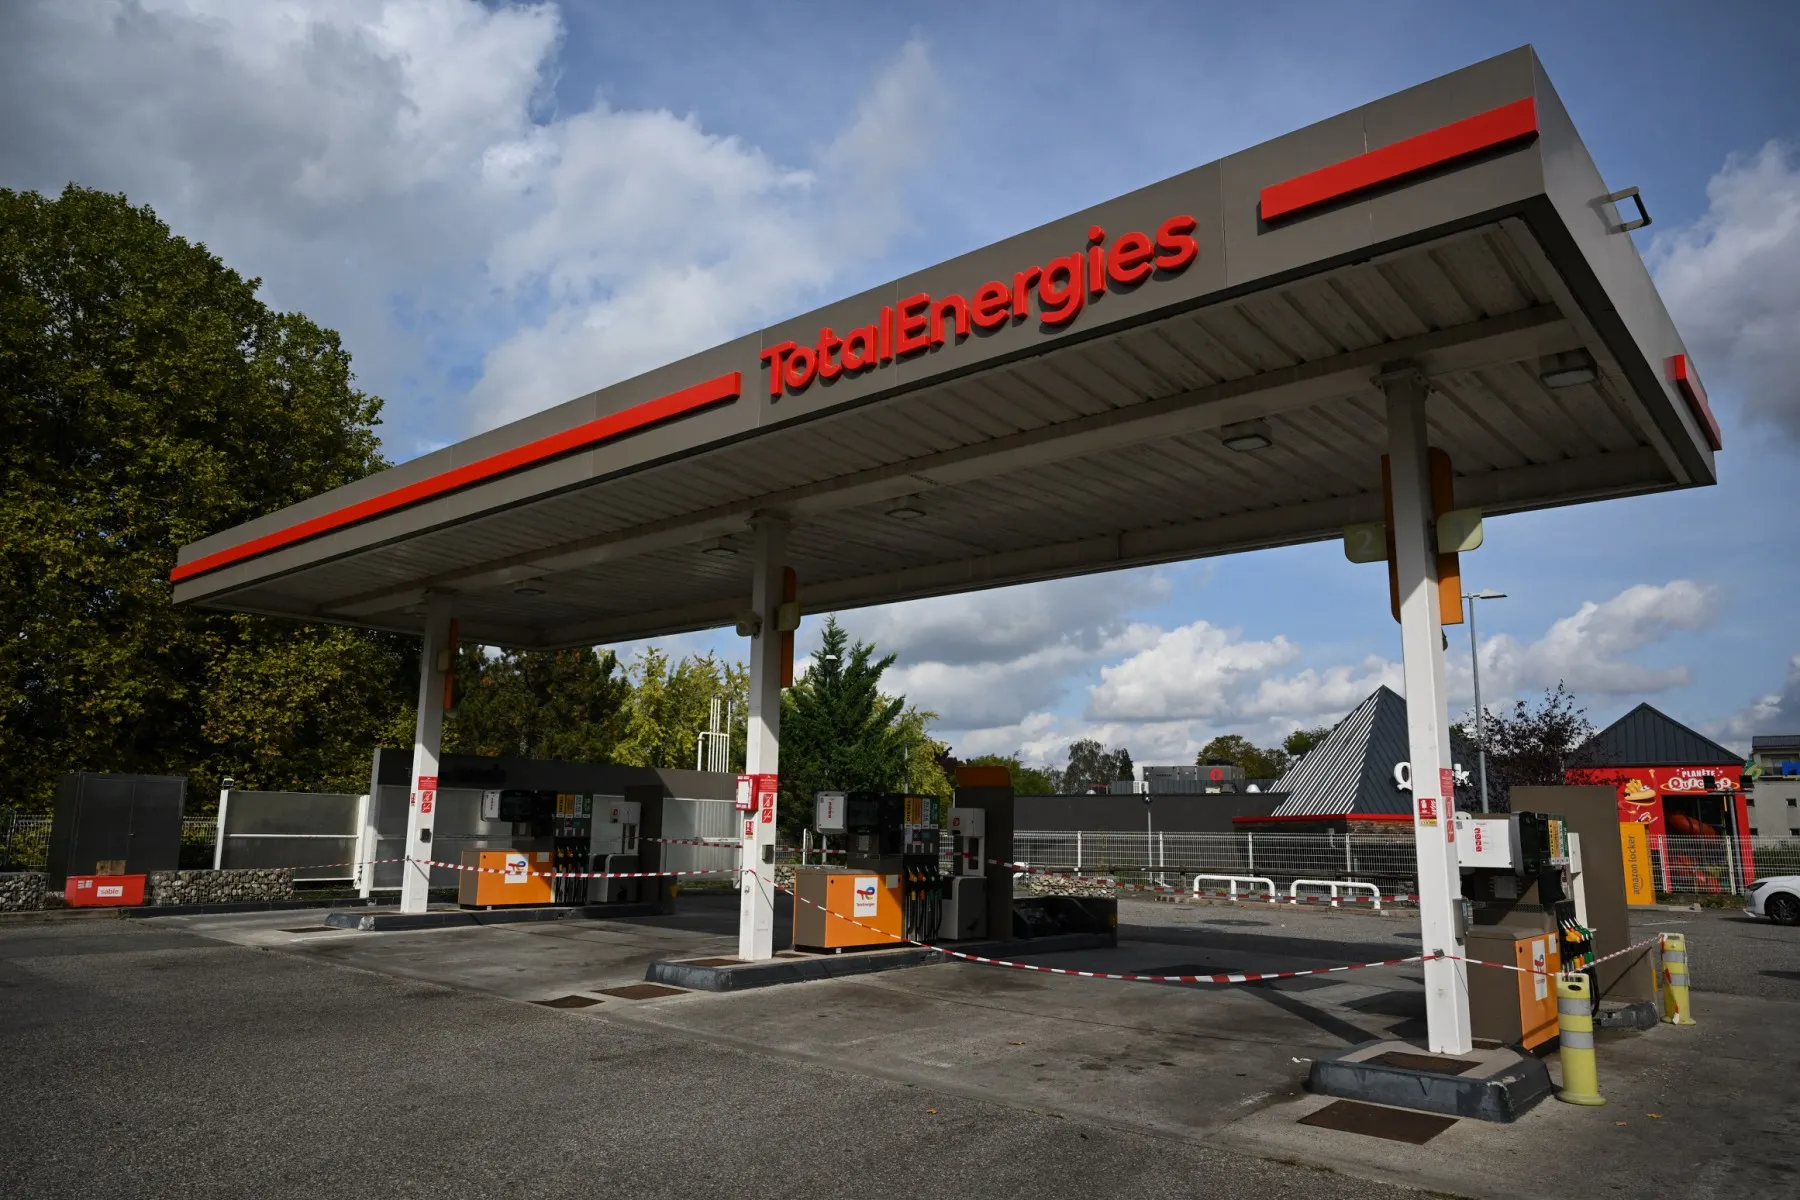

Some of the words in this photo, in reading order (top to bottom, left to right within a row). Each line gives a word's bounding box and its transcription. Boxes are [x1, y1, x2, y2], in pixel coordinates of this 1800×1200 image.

[760, 215, 1198, 397] TotalEnergies
[1681, 769, 1716, 778] PLANÈTE
[1627, 835, 1637, 863] locker
[100, 887, 119, 895] sable
[1630, 864, 1641, 895] amazon
